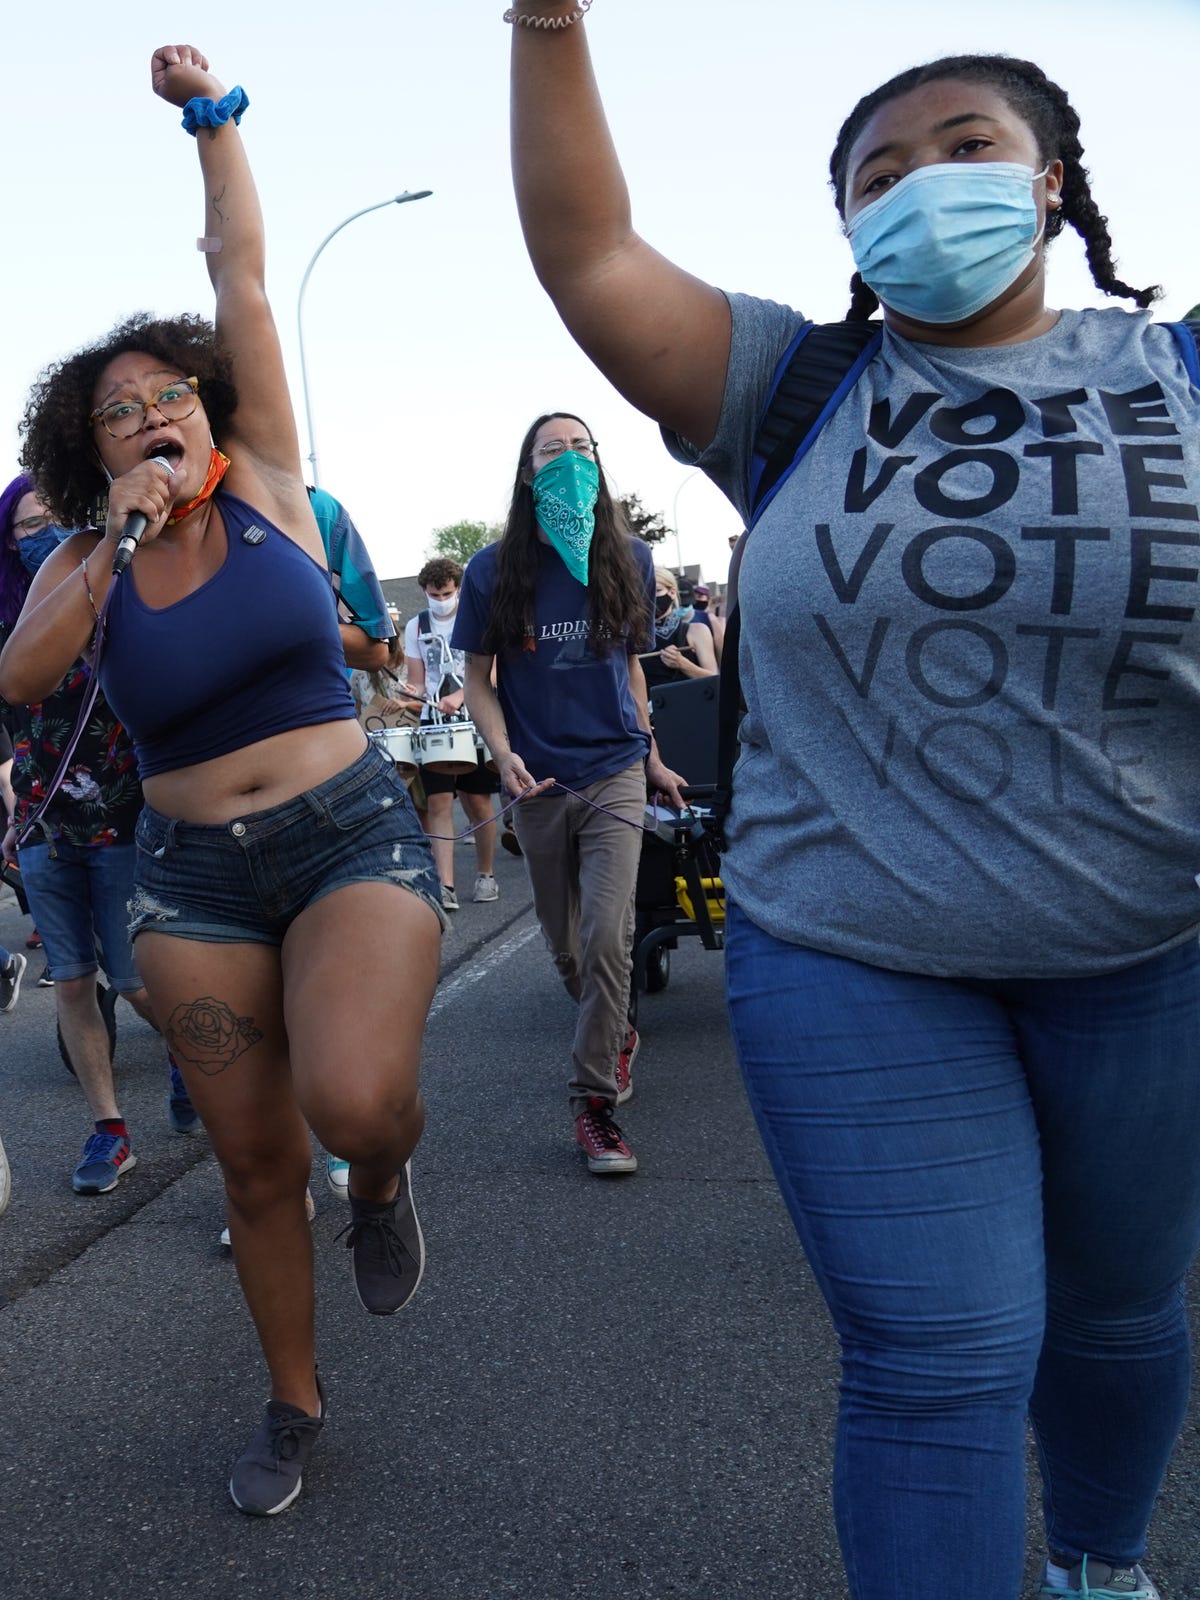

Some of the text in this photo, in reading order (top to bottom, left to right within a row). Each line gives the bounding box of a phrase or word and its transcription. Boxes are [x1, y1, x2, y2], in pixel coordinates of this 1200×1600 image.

[867, 381, 1181, 449] VOTE
[844, 440, 1199, 520] VOTE
[814, 523, 1200, 621] VOTE
[812, 613, 1183, 711] VOTE
[836, 706, 1154, 806] VOTE
